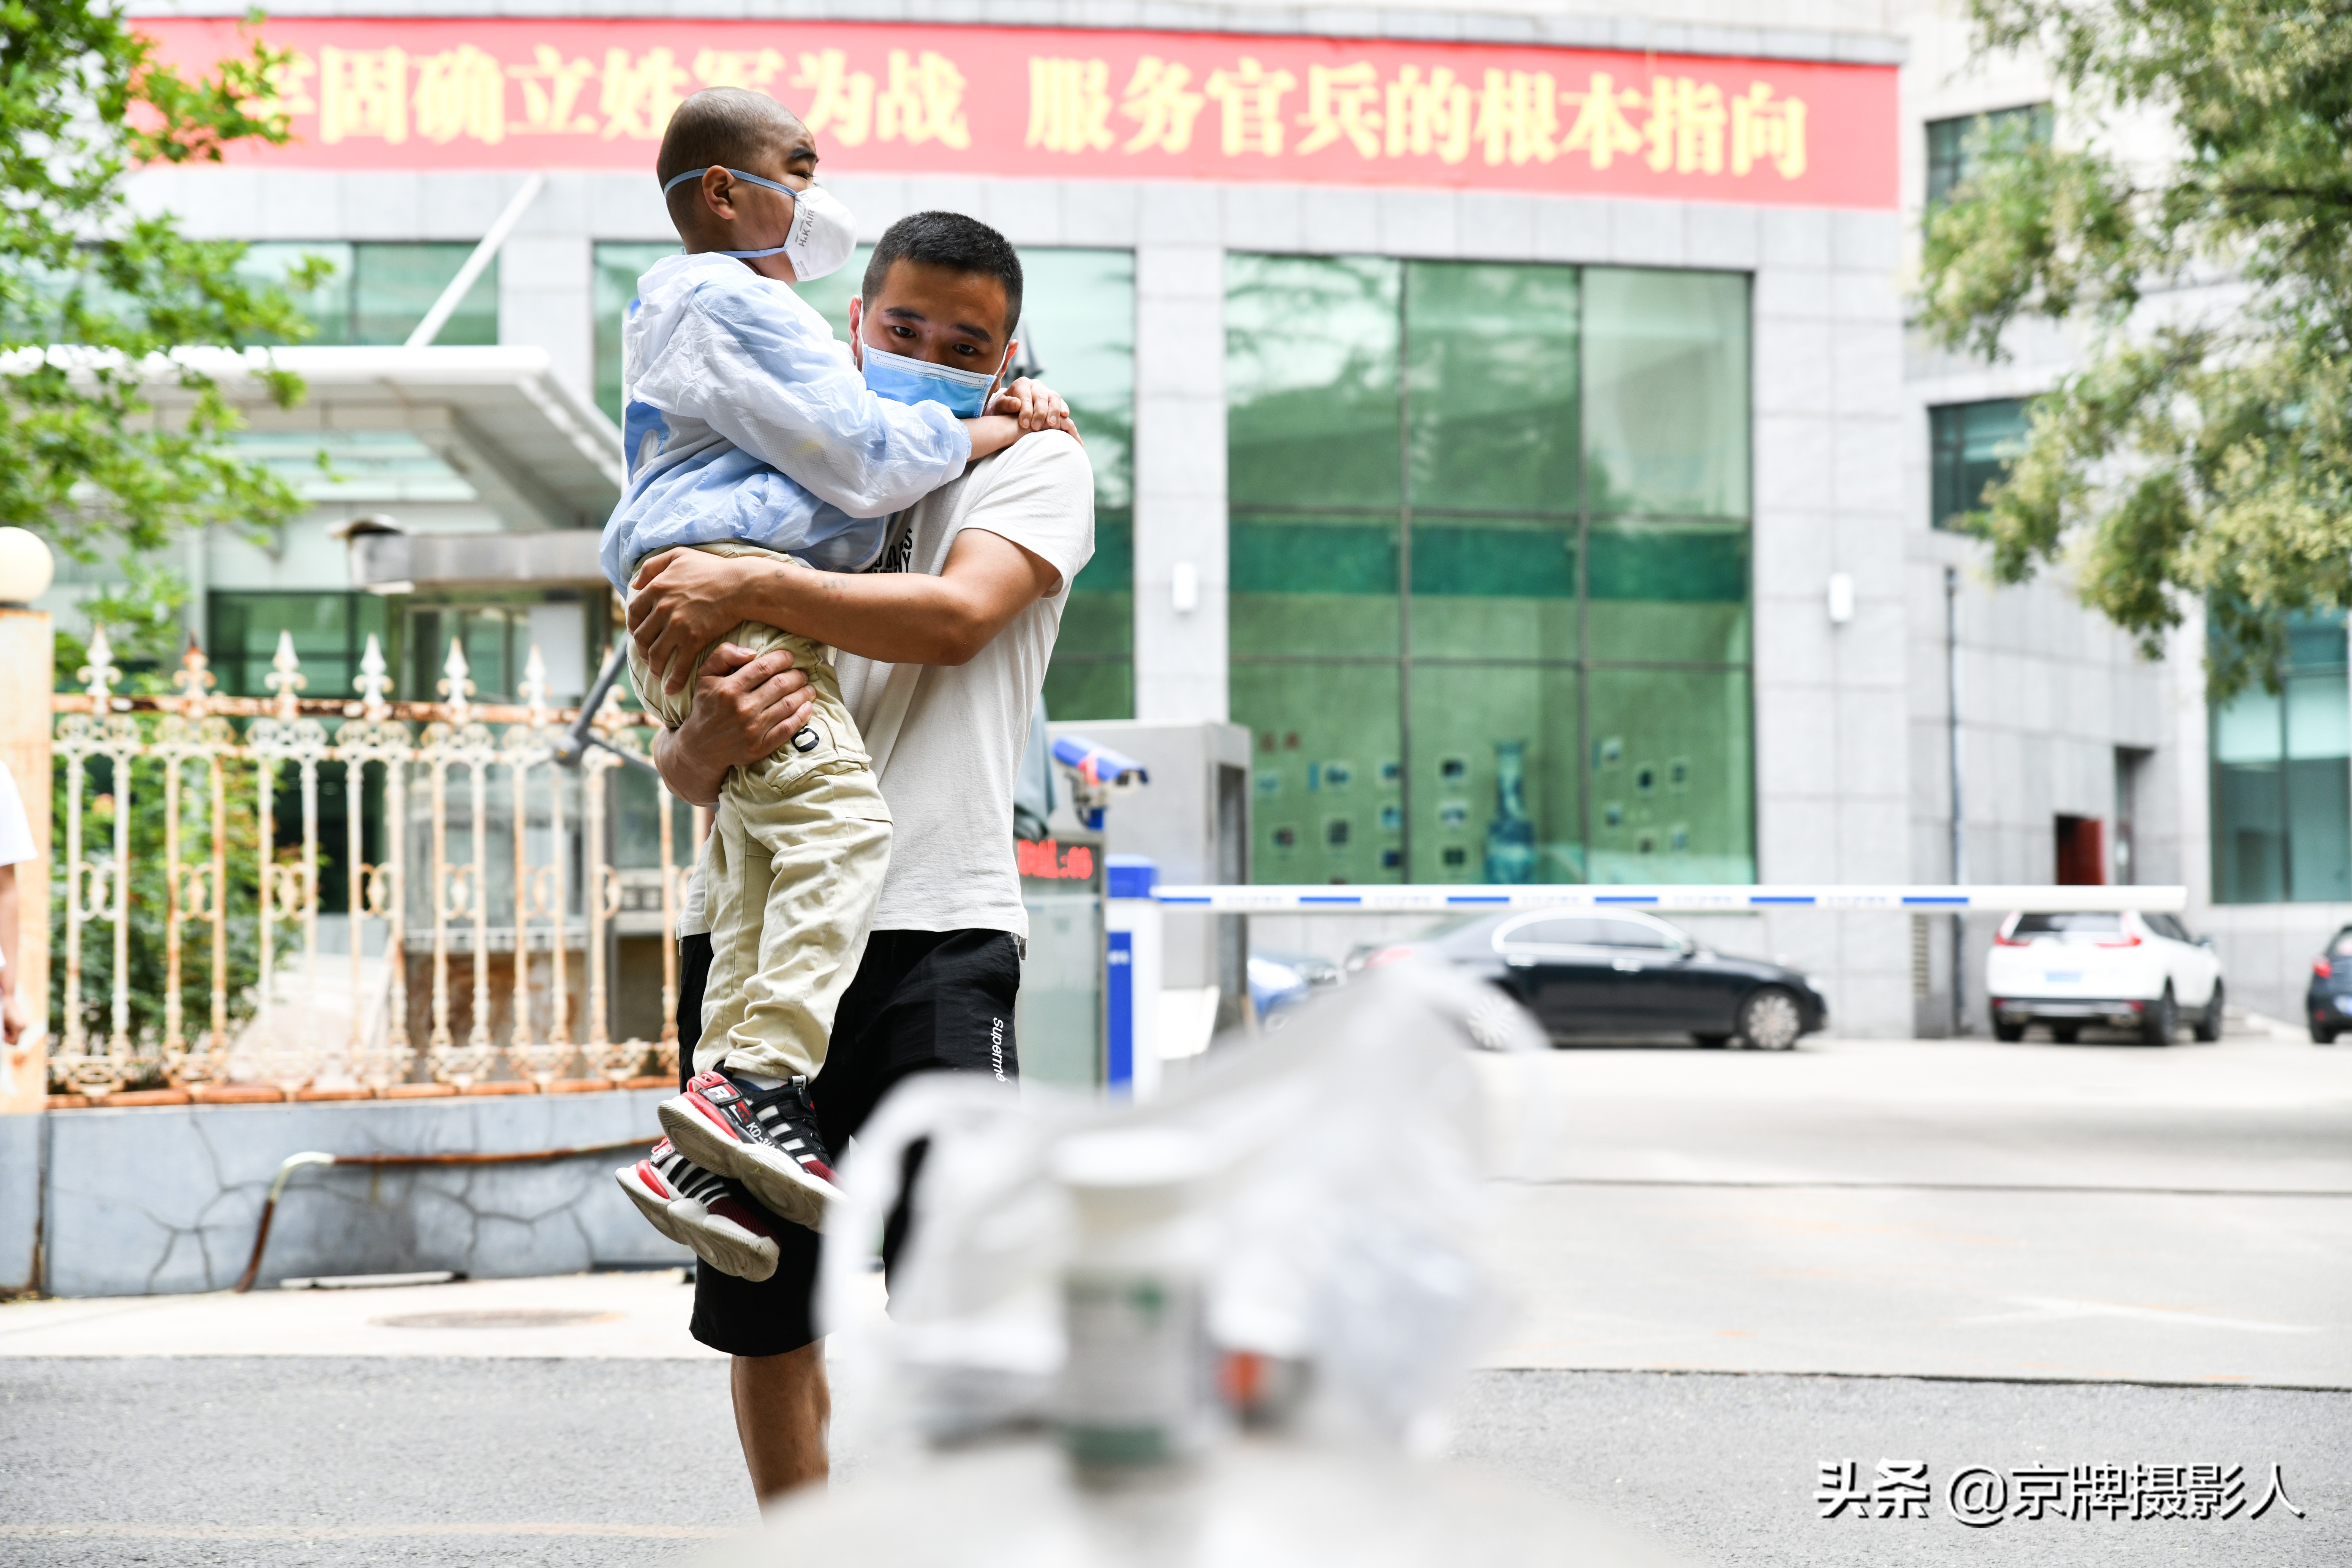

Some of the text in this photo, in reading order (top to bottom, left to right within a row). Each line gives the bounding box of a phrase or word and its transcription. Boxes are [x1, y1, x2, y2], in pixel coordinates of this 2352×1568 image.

[1024, 54, 1808, 181] 服务官兵的根本指向
[805, 209, 814, 228] AIR
